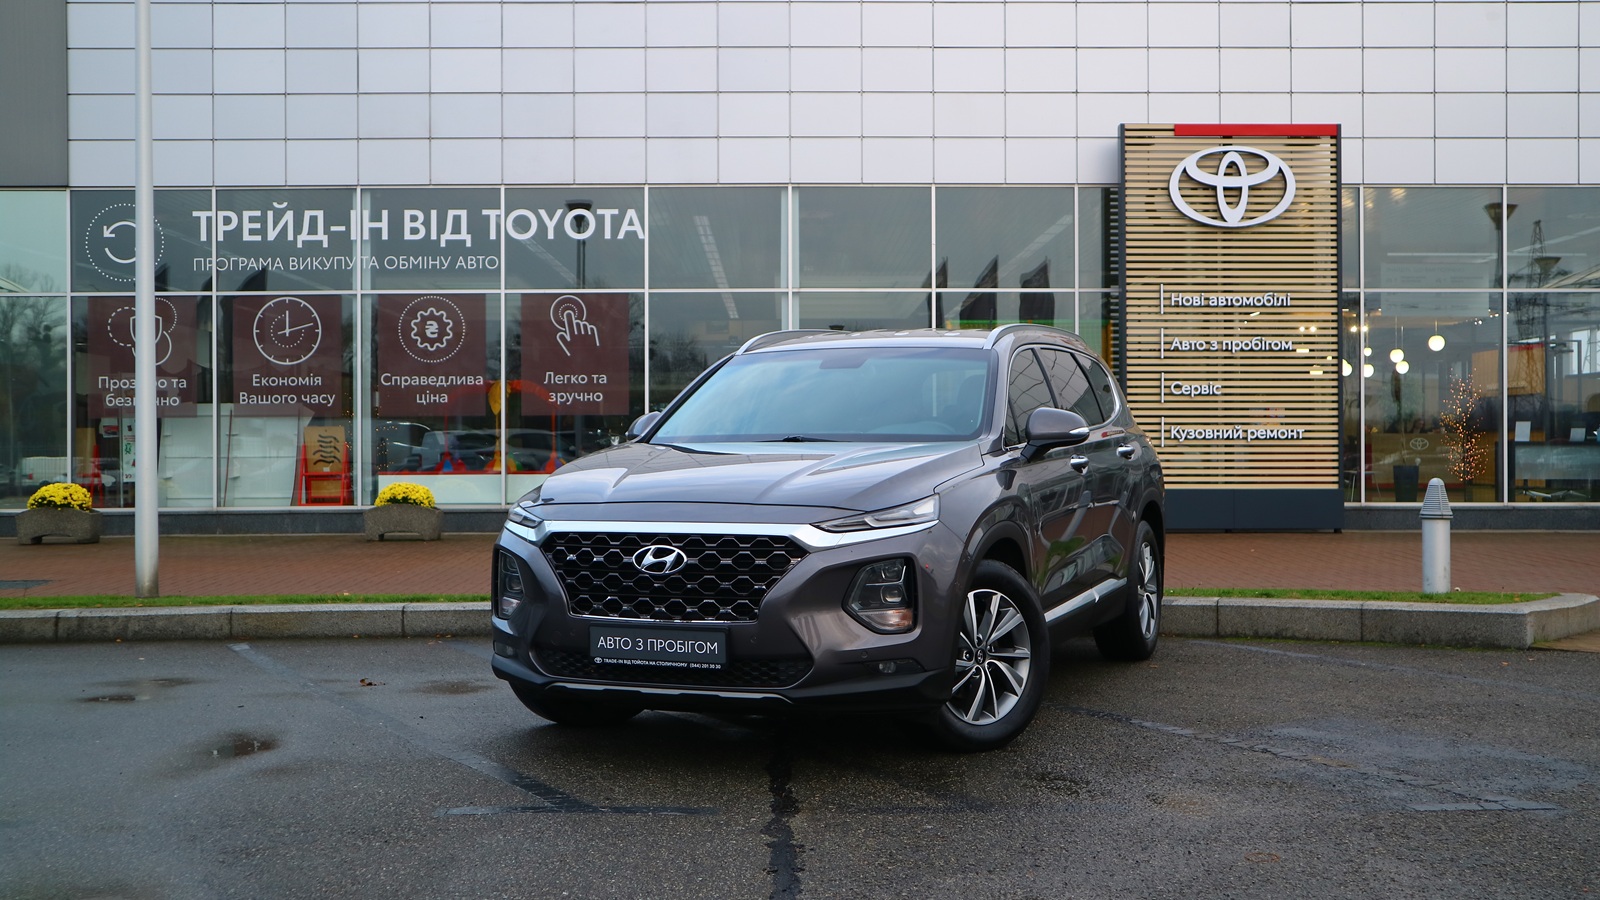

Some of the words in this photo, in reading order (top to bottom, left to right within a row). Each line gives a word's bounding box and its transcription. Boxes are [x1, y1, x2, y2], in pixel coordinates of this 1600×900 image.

[192, 201, 389, 248] ТРЕЙД-ІН
[403, 208, 472, 248] ВІД
[481, 208, 645, 240] TOYOTA
[193, 257, 284, 272] ПРОГРАМА
[289, 256, 355, 271] ВИКУПУ
[361, 256, 379, 270] ТА
[384, 255, 452, 270] ОБМІНУ
[455, 255, 499, 270] АВТО
[1170, 293, 1205, 307] Нові
[1209, 292, 1291, 307] автомобілі
[1170, 337, 1206, 351] Авто
[1209, 340, 1219, 351] з
[1222, 337, 1293, 353] пробігом
[98, 376, 167, 392] Прозо
[170, 378, 187, 389] та
[252, 374, 322, 387] Економія
[380, 373, 484, 388] Справедлива
[544, 372, 588, 385] Легко
[591, 374, 607, 386] та
[1170, 381, 1222, 398] Сервіс
[239, 392, 298, 405] Вашого
[301, 394, 336, 407] часу
[416, 391, 448, 405] ціна
[548, 392, 604, 407] зручно
[1170, 425, 1243, 442] Кузовний
[1247, 428, 1305, 442] ремонт
[597, 636, 632, 651] АВТО
[647, 638, 718, 655] ПРОБІГОМ
